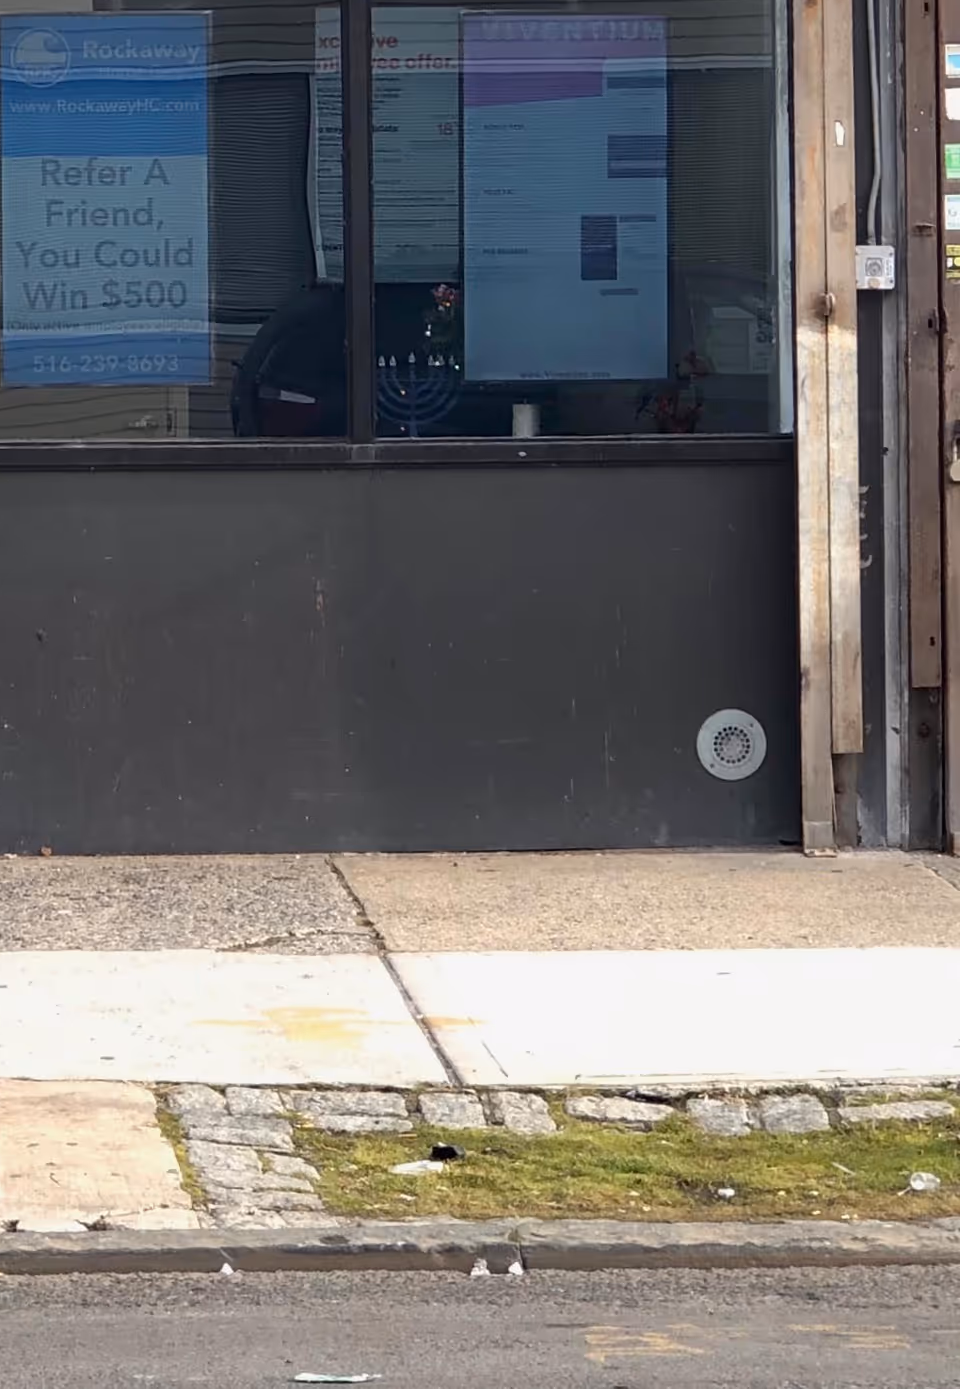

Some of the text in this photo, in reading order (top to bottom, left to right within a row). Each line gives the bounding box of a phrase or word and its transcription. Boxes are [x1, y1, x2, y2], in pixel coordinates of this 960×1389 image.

[82, 39, 201, 65] Rockaway
[9, 98, 200, 115] www.RockawayHC.com
[41, 158, 171, 187] Refer A
[45, 197, 164, 230] Friend,
[16, 237, 194, 269] You Could
[23, 278, 188, 311] Win $500
[33, 354, 180, 373] 516-239-8693
